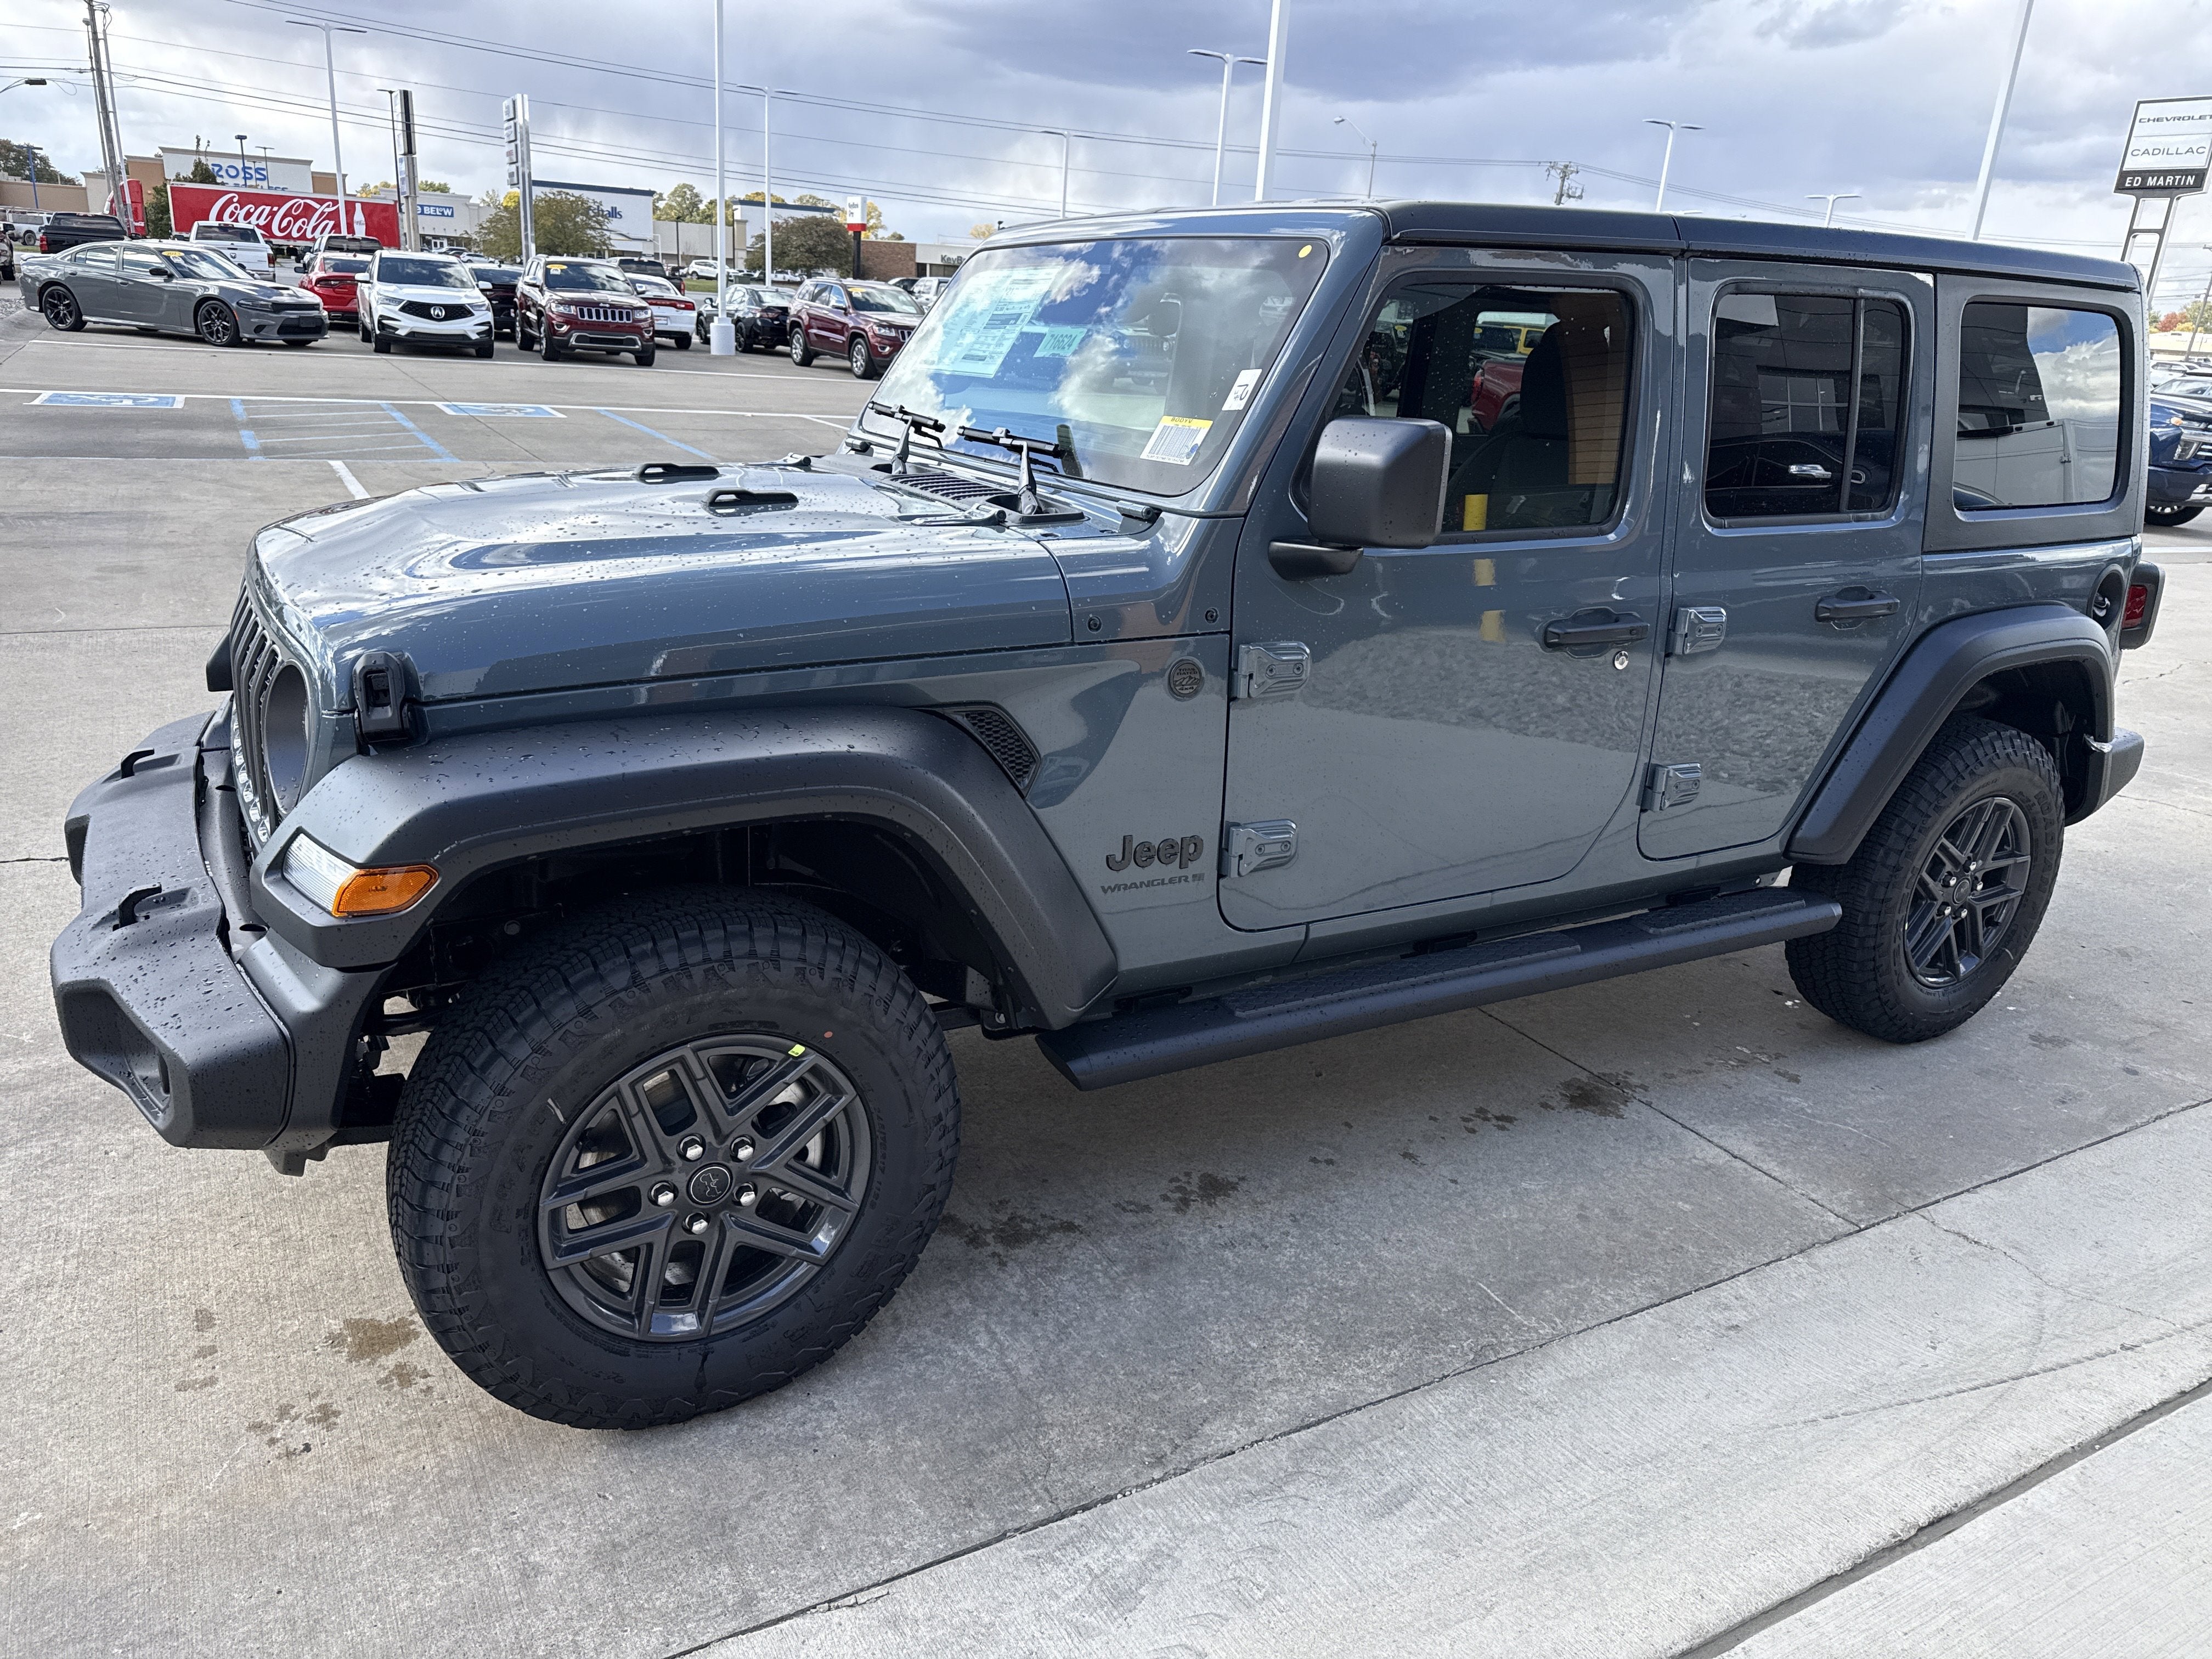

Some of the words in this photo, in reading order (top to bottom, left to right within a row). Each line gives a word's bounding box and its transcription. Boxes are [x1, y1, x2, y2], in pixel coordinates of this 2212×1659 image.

[2131, 146, 2207, 157] CADILLAC
[211, 163, 267, 182] ROSS
[2124, 176, 2142, 187] ED
[2146, 175, 2196, 186] MARTIN
[208, 193, 340, 239] Coca-Cola
[424, 206, 453, 216] BELOW
[1105, 834, 1204, 872] Jeep
[1101, 875, 1189, 894] WRANGLER
